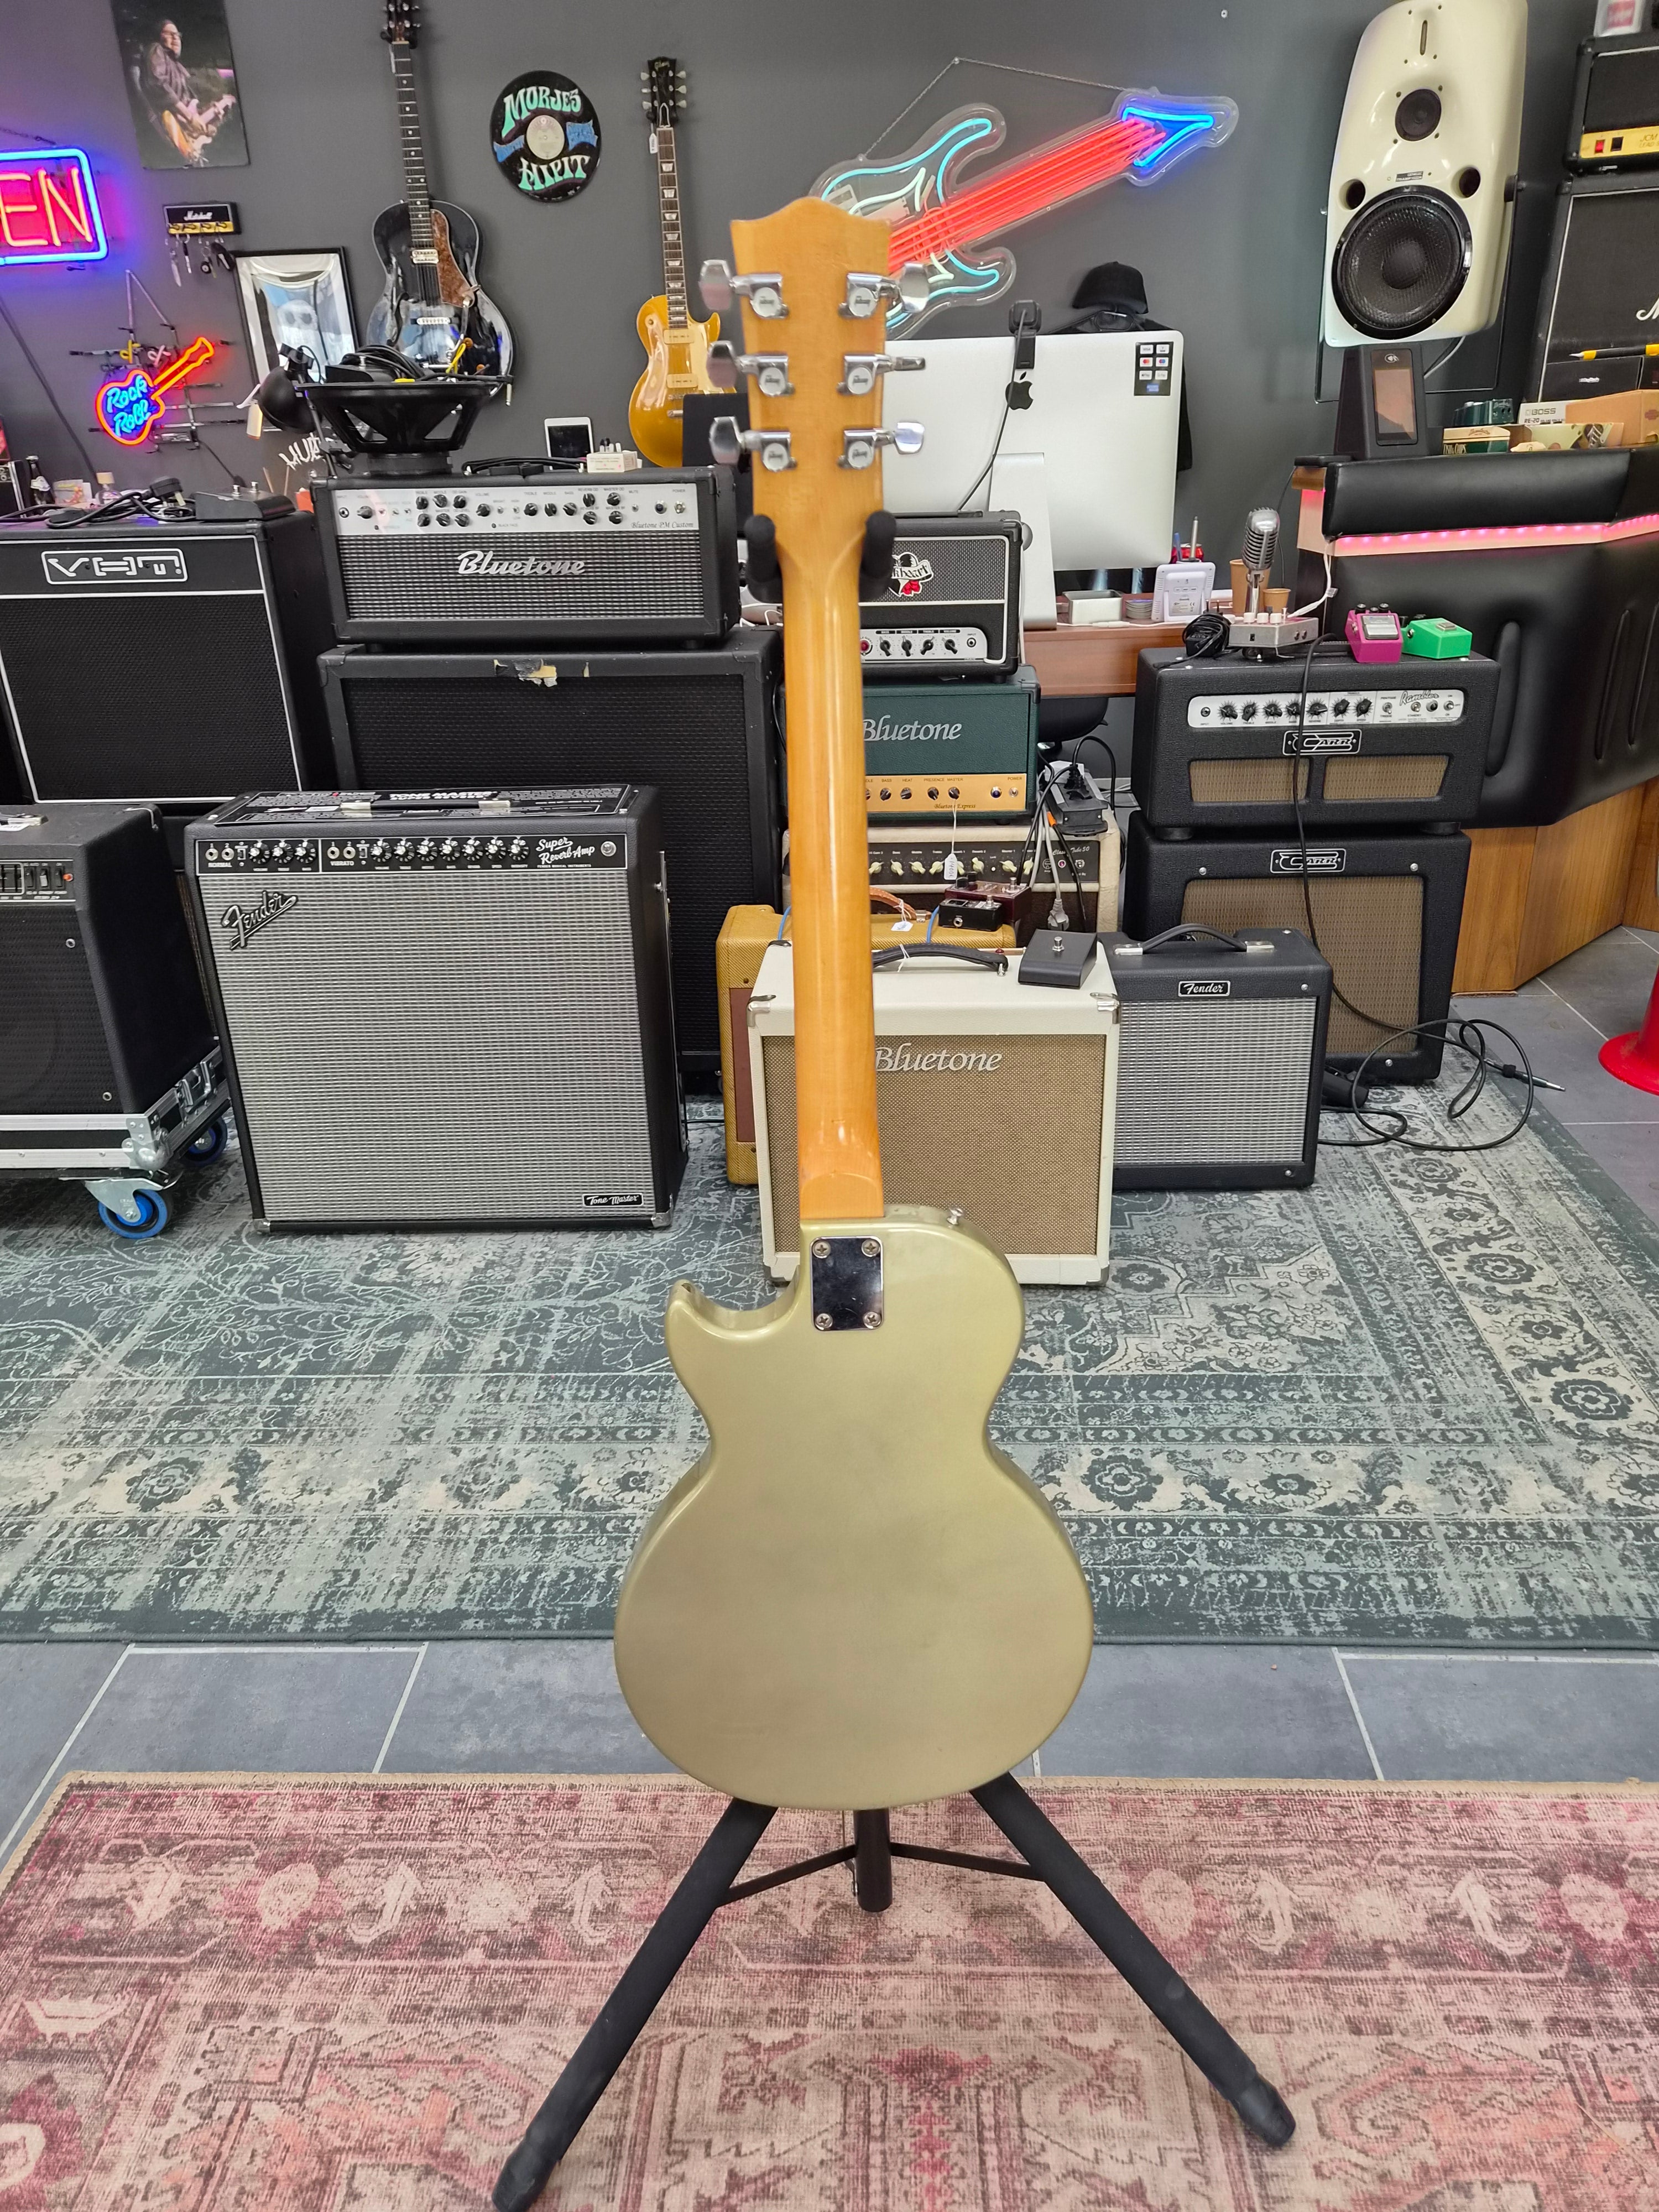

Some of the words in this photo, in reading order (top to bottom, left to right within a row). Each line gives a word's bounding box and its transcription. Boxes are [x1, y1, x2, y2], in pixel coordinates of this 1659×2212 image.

[502, 86, 581, 138] MORJES
[518, 154, 590, 191] HIPIT
[106, 374, 148, 413] Rock
[113, 399, 152, 437] Roll
[457, 550, 586, 575] Bluetone
[893, 565, 928, 578] kheart
[1400, 690, 1439, 706] Rambler
[863, 714, 962, 741] Bluetone
[535, 837, 573, 852] Super
[539, 845, 596, 864] Reverb-Amp
[222, 891, 296, 947] Fender
[1183, 983, 1223, 994] Fender
[875, 1042, 1003, 1071] Bluetone
[586, 1196, 608, 1205] Tone
[608, 1195, 638, 1205] Master
